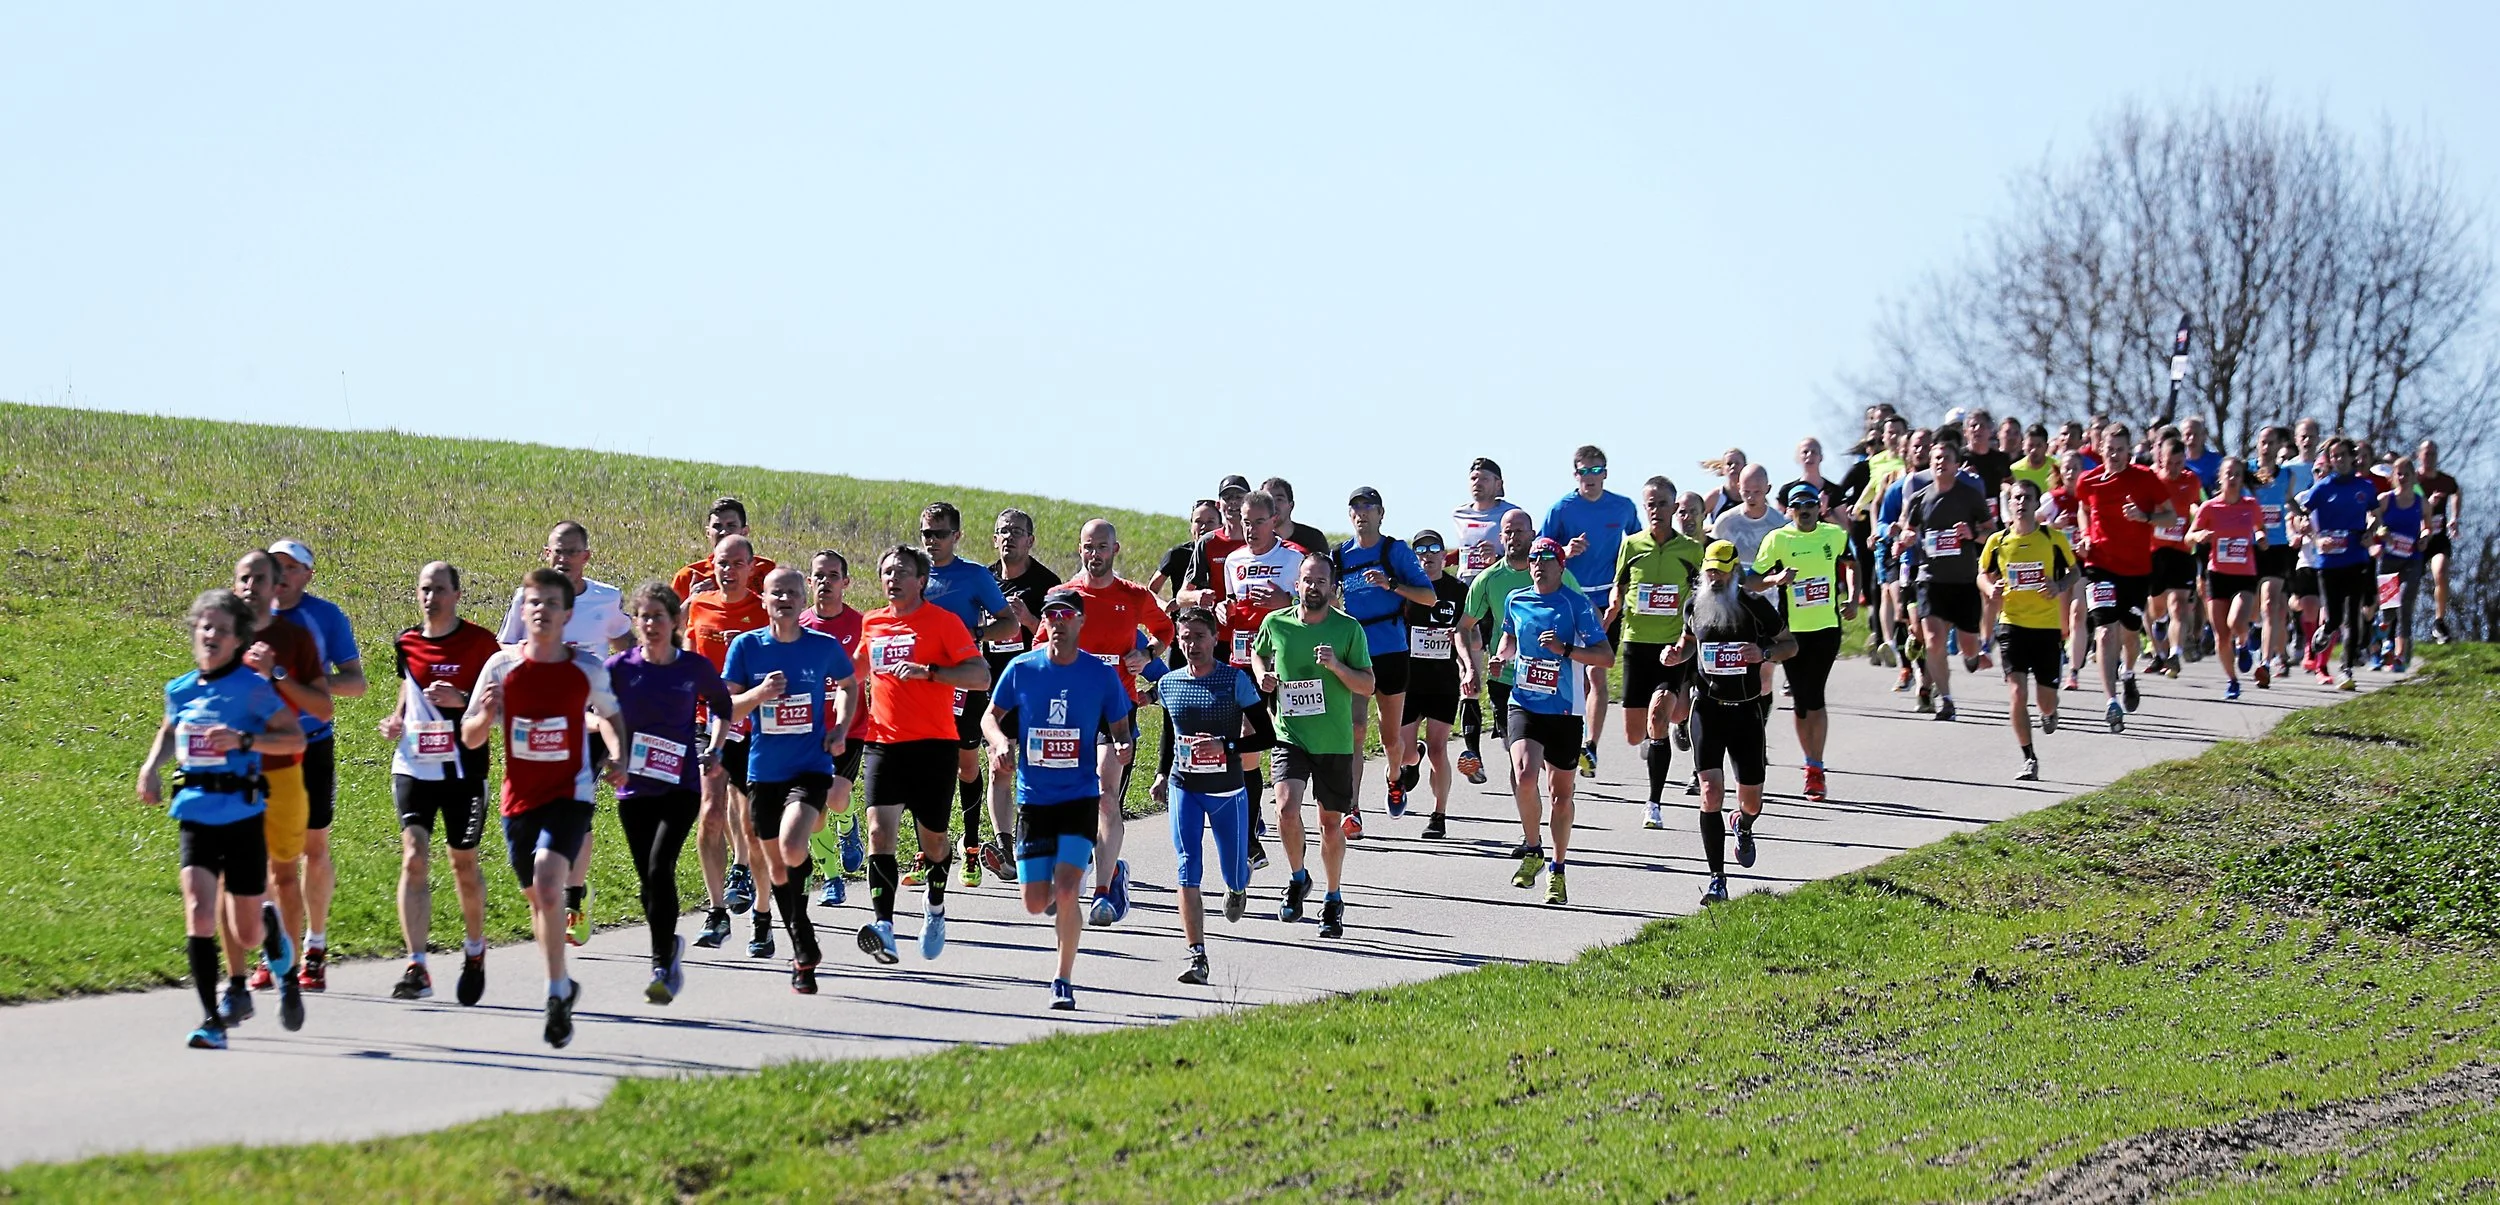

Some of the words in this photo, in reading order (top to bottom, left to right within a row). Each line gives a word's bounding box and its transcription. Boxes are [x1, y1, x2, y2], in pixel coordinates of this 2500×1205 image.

[1247, 565, 1283, 576] BRC
[1808, 585, 1828, 596] 3242
[1652, 594, 1675, 603] 3094
[1423, 639, 1451, 650] 50177
[886, 646, 910, 658] 3135
[1719, 653, 1742, 662] 3060
[429, 663, 461, 672] TRT
[1530, 669, 1554, 681] 3126
[1283, 681, 1314, 690] MIGROS
[1291, 692, 1323, 706] 50113
[780, 707, 808, 719] 2122
[1035, 729, 1072, 738] MIGROS
[641, 735, 678, 752] MIGROS
[1047, 741, 1075, 752] 3133
[650, 750, 678, 767] 3065
